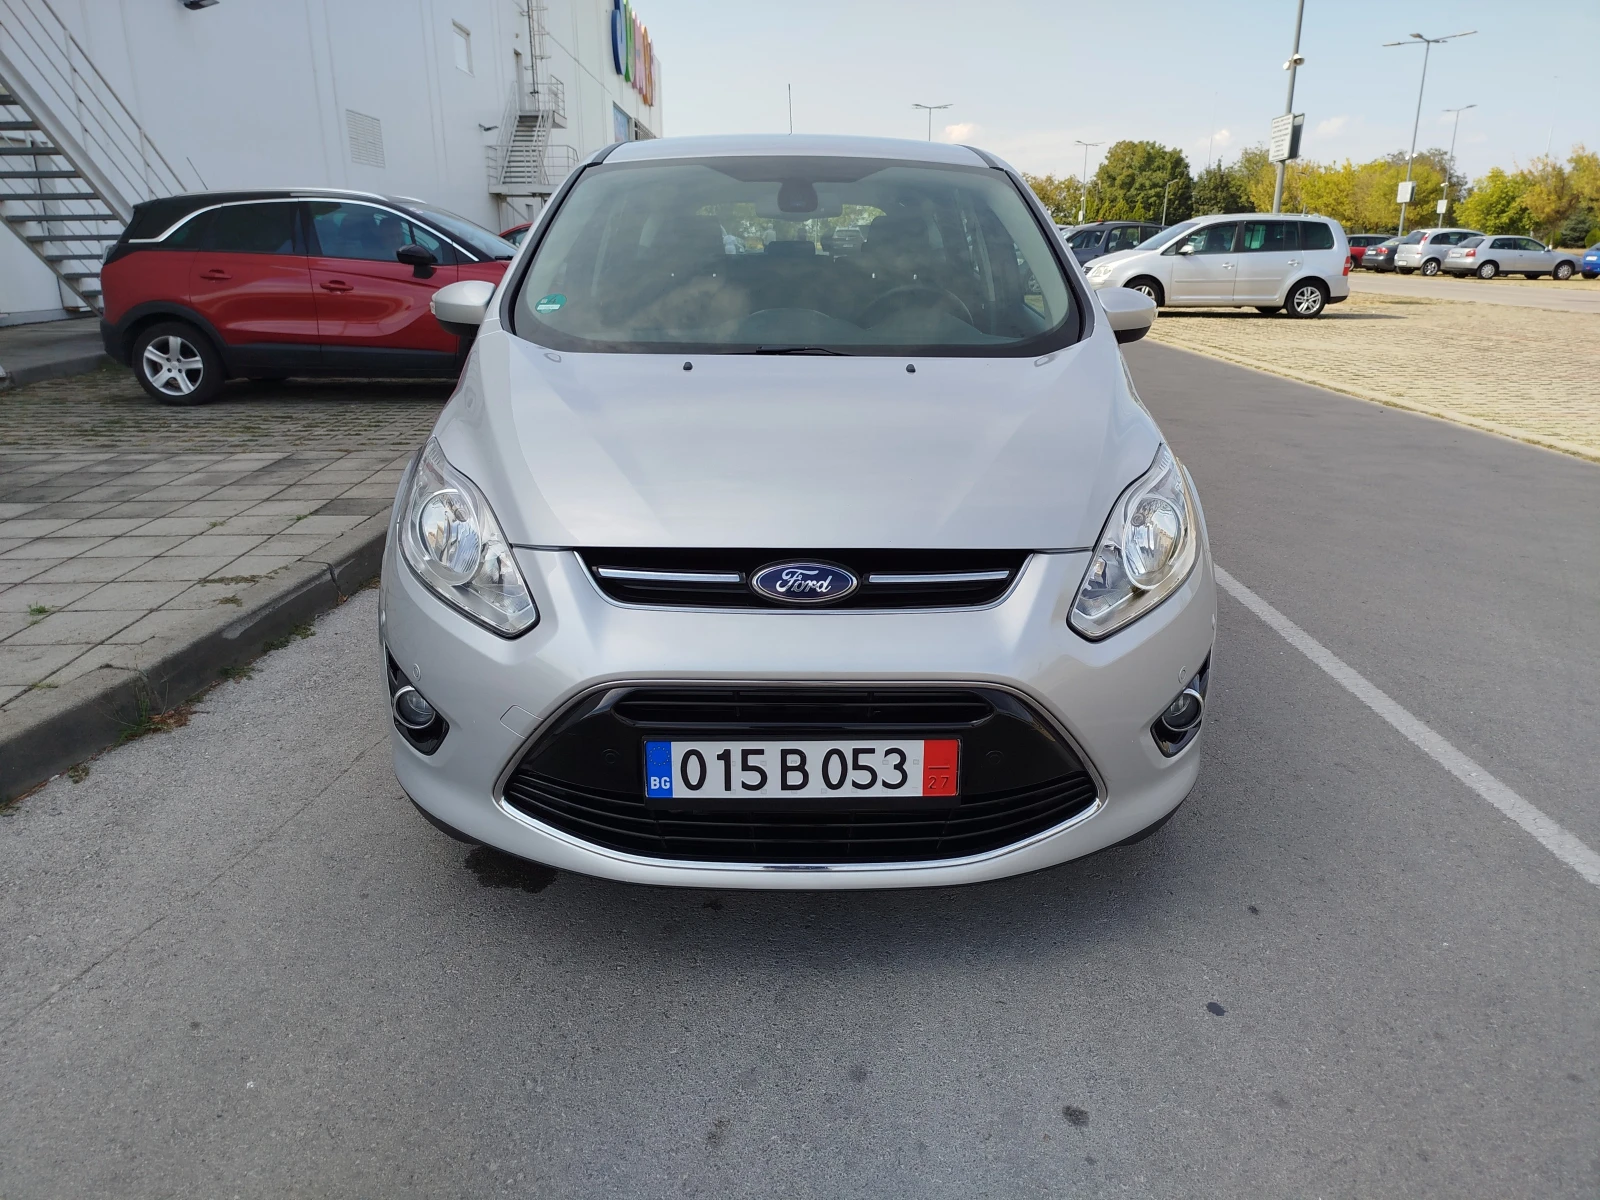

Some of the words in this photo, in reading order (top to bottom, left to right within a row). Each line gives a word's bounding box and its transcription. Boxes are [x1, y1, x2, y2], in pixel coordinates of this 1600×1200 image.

[776, 569, 832, 592] Ford
[650, 776, 671, 790] BG
[927, 775, 950, 790] 27
